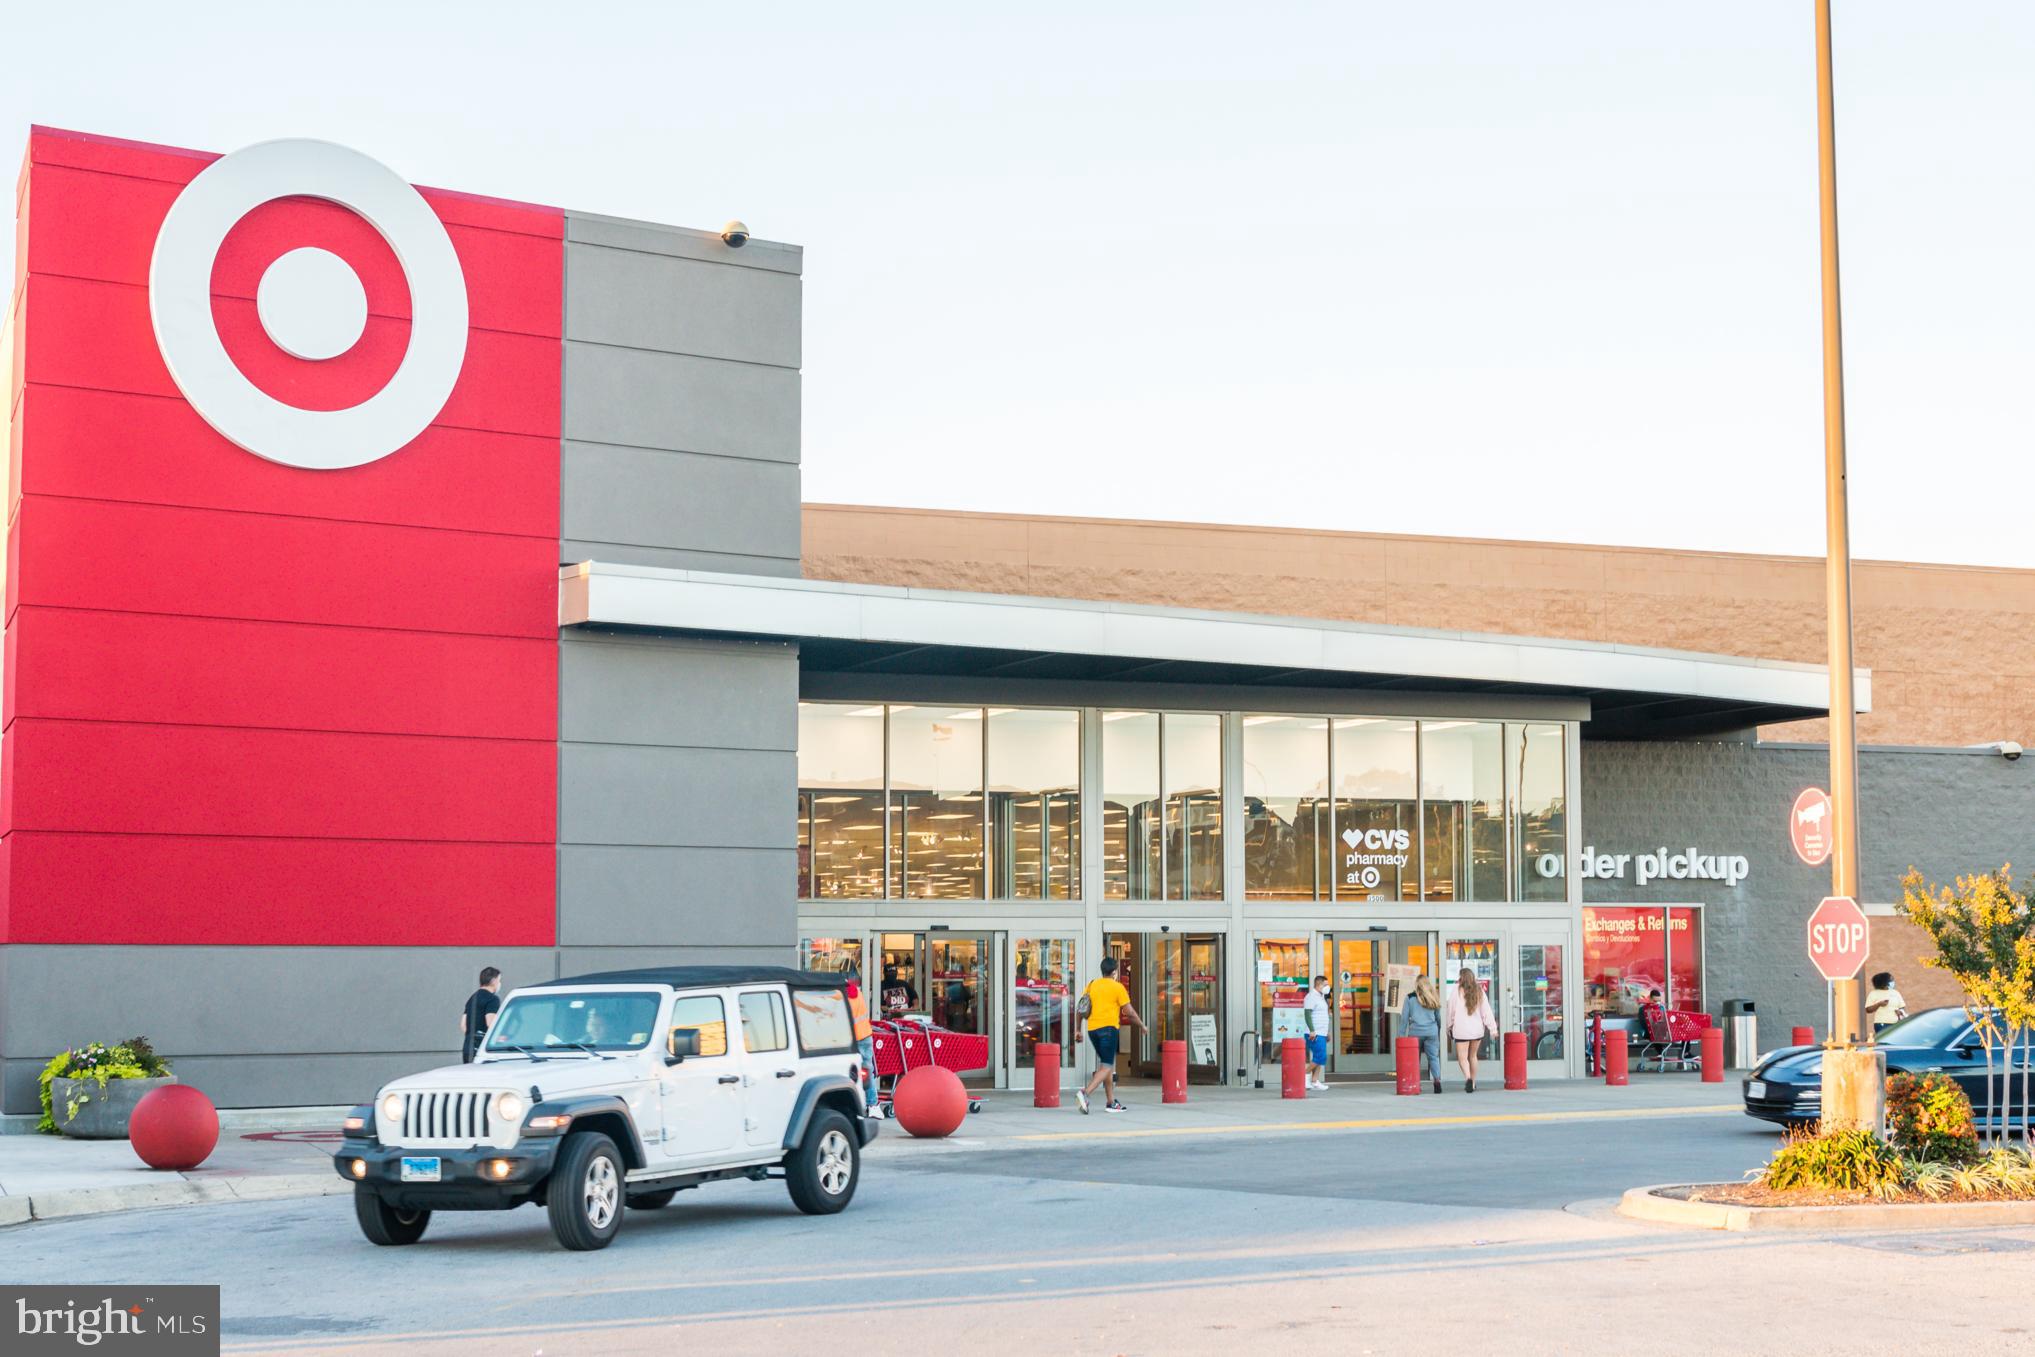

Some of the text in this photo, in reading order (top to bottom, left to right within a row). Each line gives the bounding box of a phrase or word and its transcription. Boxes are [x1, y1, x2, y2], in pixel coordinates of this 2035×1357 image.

[1364, 828, 1410, 850] CVS
[1346, 852, 1408, 867] pharmacy
[1535, 845, 1749, 886] oder pickup
[1346, 871, 1359, 884] at
[1584, 915, 1688, 934] Exchanges & Retrns
[1812, 923, 1864, 954] STOP
